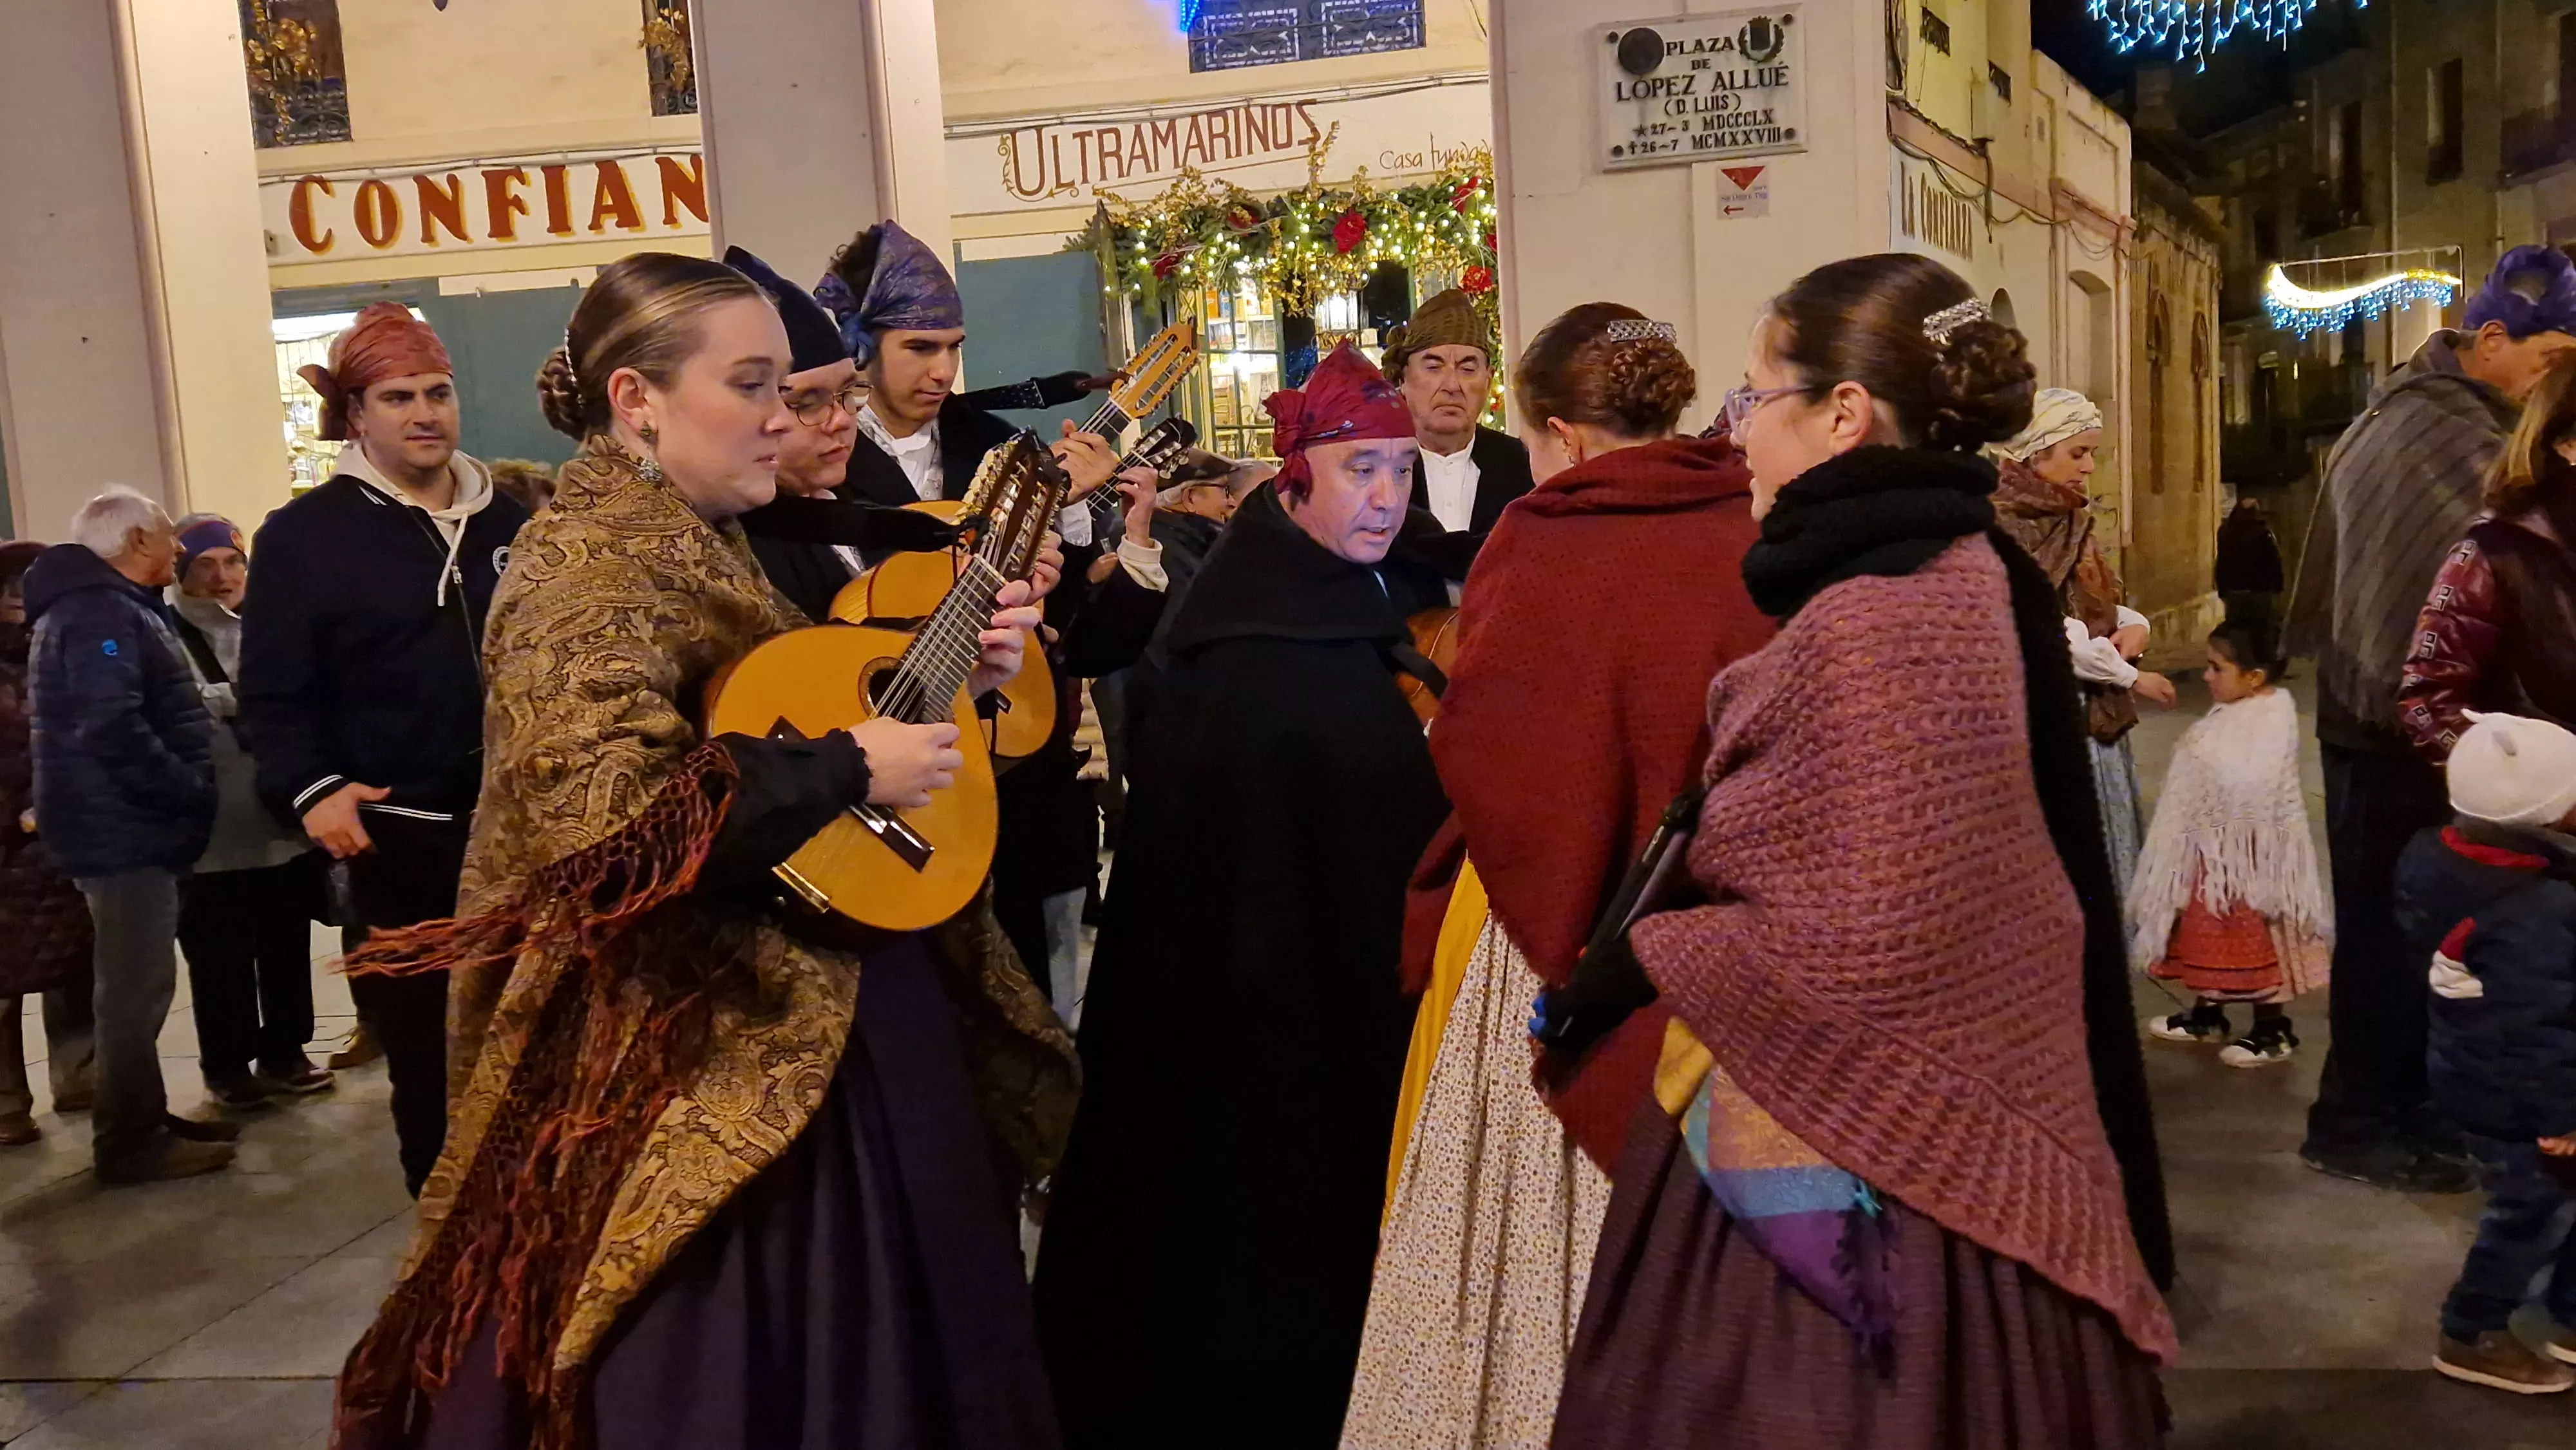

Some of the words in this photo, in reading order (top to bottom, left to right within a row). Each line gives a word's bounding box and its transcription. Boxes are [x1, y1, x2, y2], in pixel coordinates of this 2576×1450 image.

[1665, 36, 1737, 57] PLAZA
[1690, 58, 1711, 71] DE
[1710, 61, 1790, 93] ALLUÉ
[1664, 99, 1689, 117] (D.
[1694, 92, 1741, 113] LUIS)
[1702, 108, 1774, 132] MDCCCLX
[1009, 98, 1321, 196] ULTRAMARINOS
[1691, 126, 1781, 150] MCMXXVIII
[1379, 150, 1423, 170] Casa
